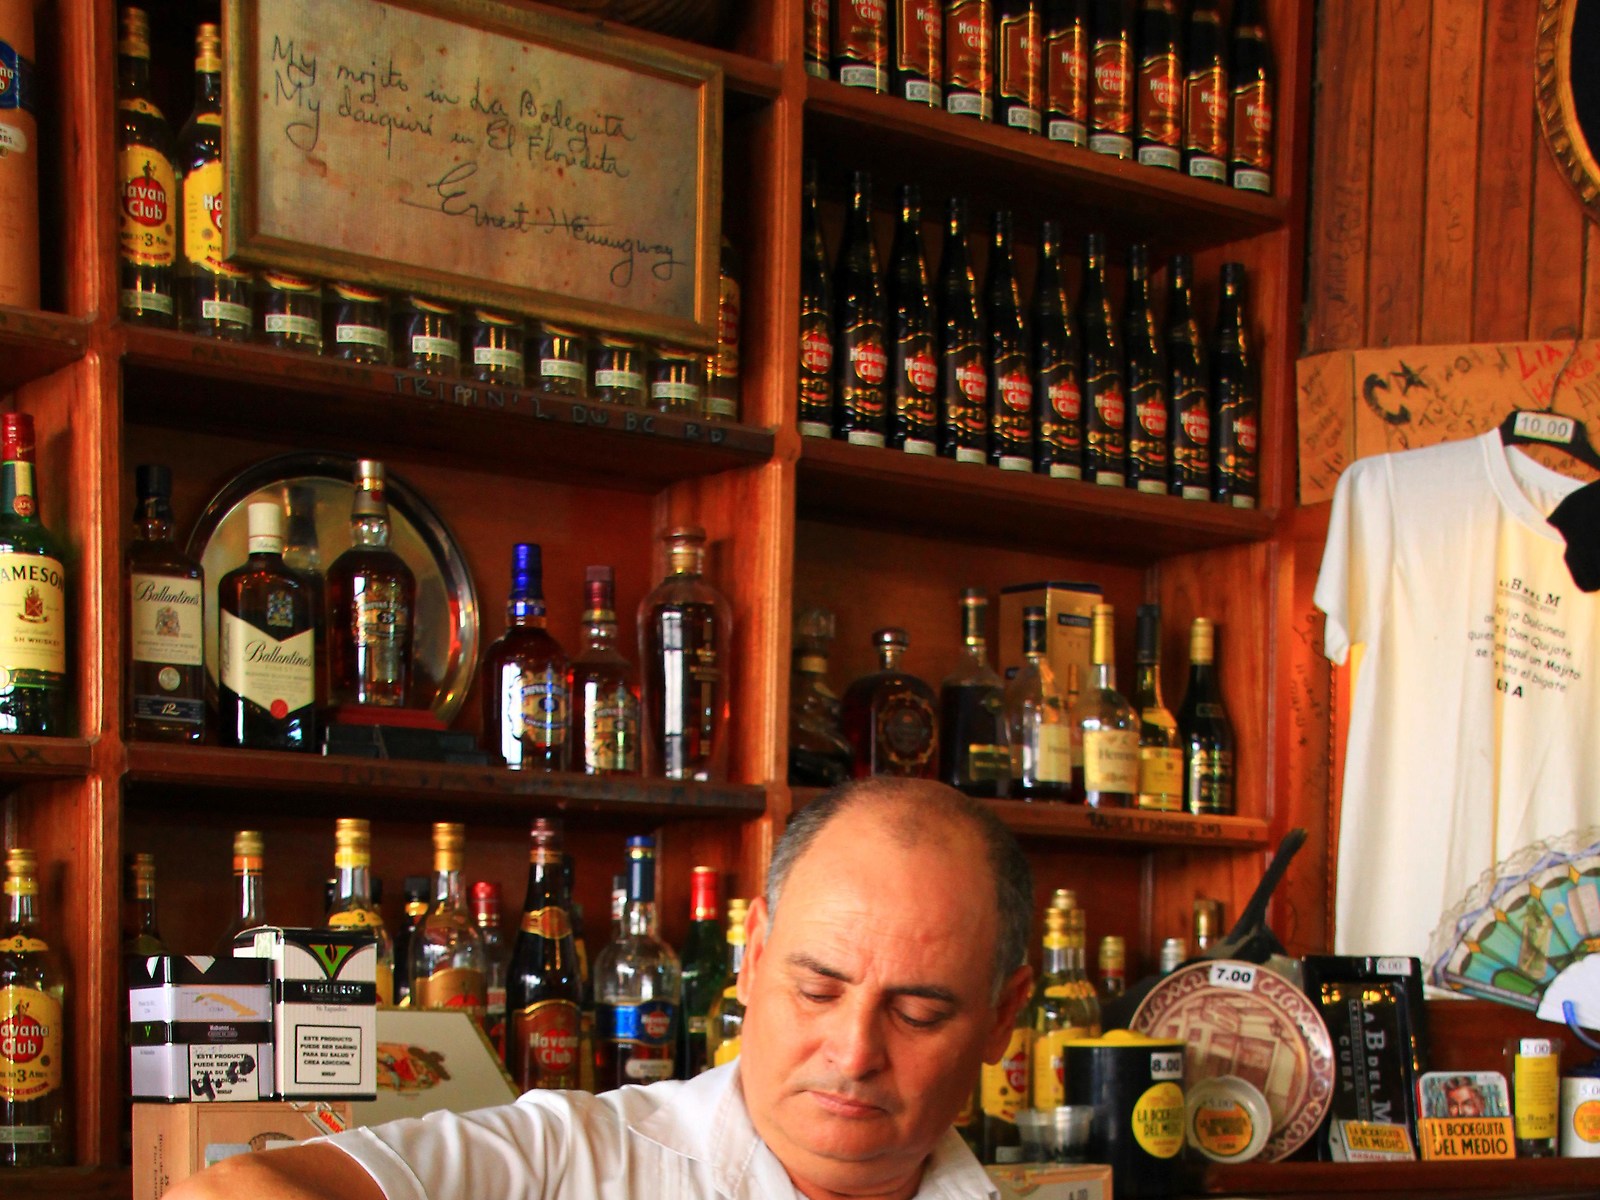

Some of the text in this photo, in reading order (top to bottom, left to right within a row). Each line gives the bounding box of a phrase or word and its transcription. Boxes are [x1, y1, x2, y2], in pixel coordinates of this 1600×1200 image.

[128, 200, 163, 220] Club
[1520, 416, 1568, 438] 10.00
[159, 703, 181, 717] 12
[1215, 968, 1251, 984] 7.00
[2, 1040, 37, 1055] Club
[1446, 1123, 1505, 1136] BODEGUITA
[1461, 1138, 1508, 1155] MEDIO
